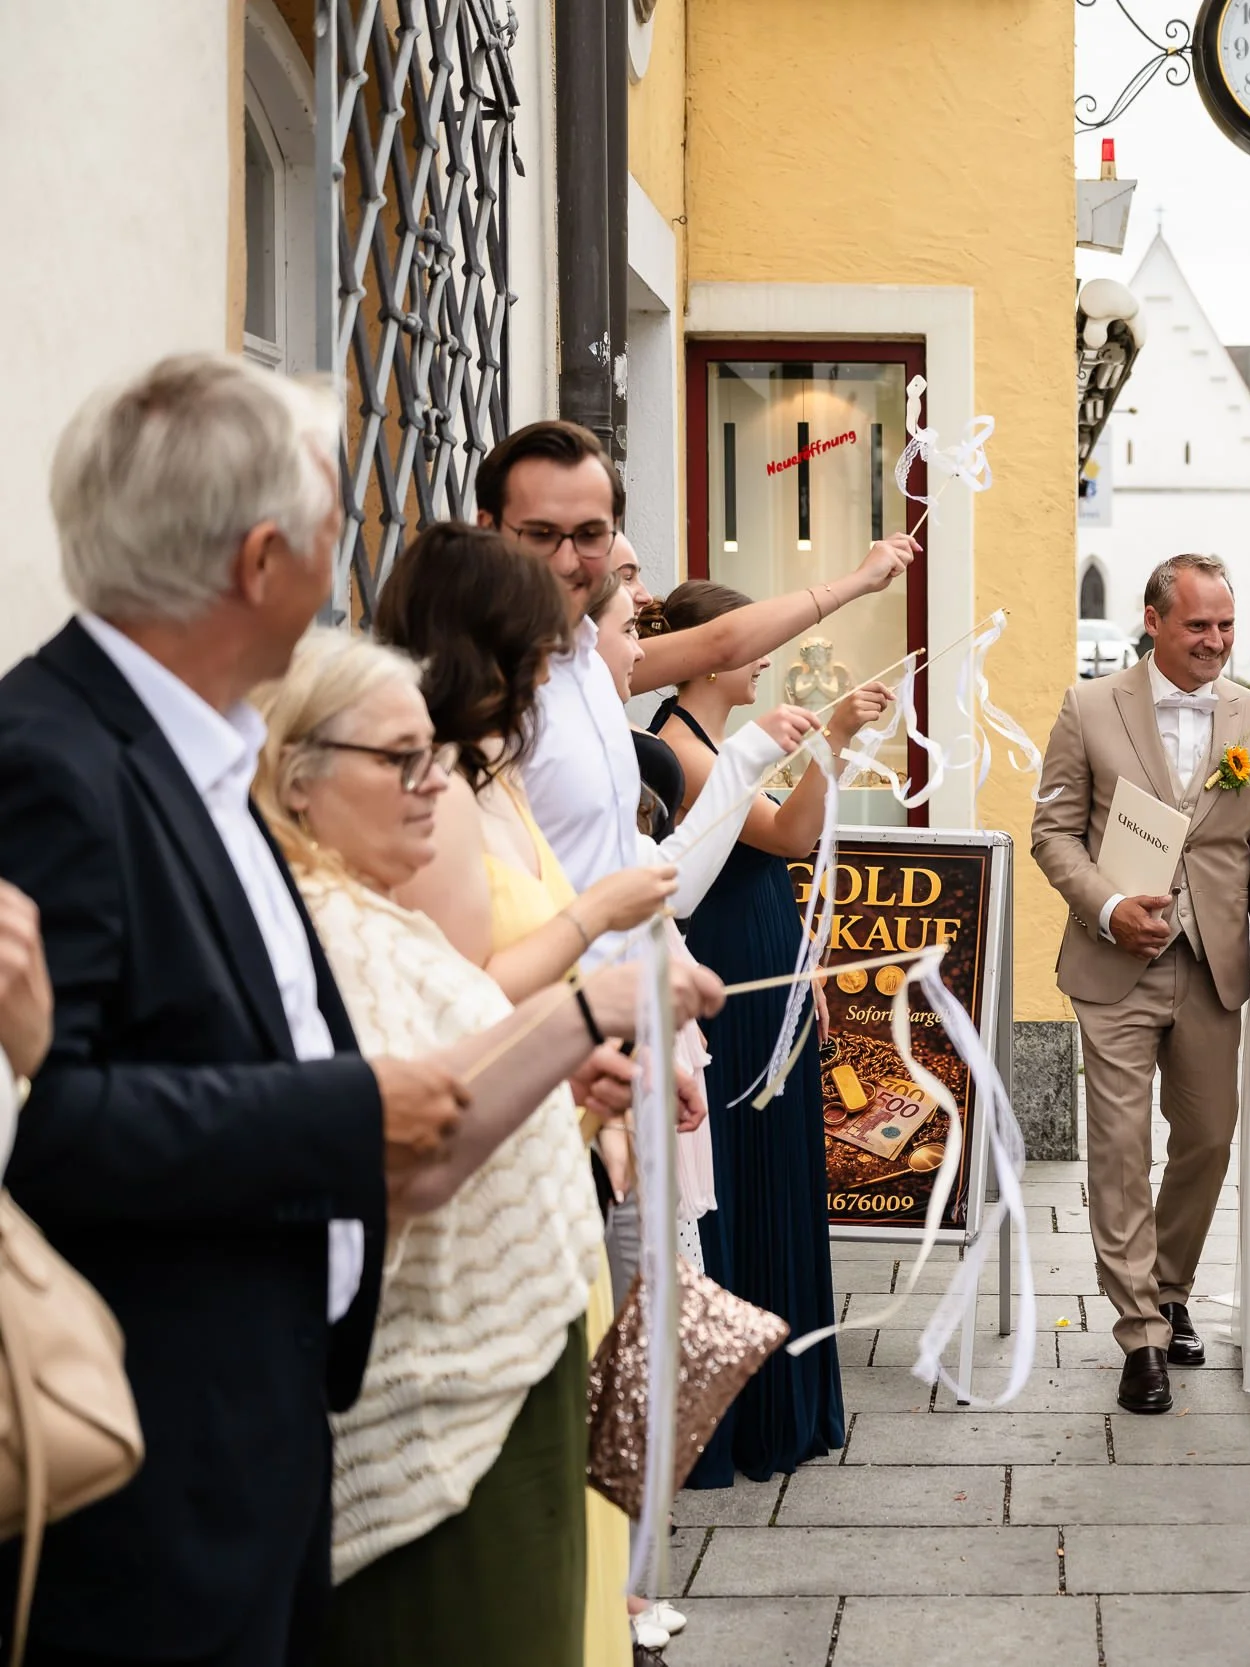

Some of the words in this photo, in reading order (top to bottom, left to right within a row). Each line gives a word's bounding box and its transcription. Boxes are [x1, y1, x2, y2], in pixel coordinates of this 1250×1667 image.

[1234, 38, 1249, 59] 9
[766, 430, 857, 476] Neueröffnung
[786, 863, 942, 907] GOLD
[846, 1005, 895, 1025] Sofort
[905, 1008, 944, 1027] arge
[877, 1091, 920, 1118] 500
